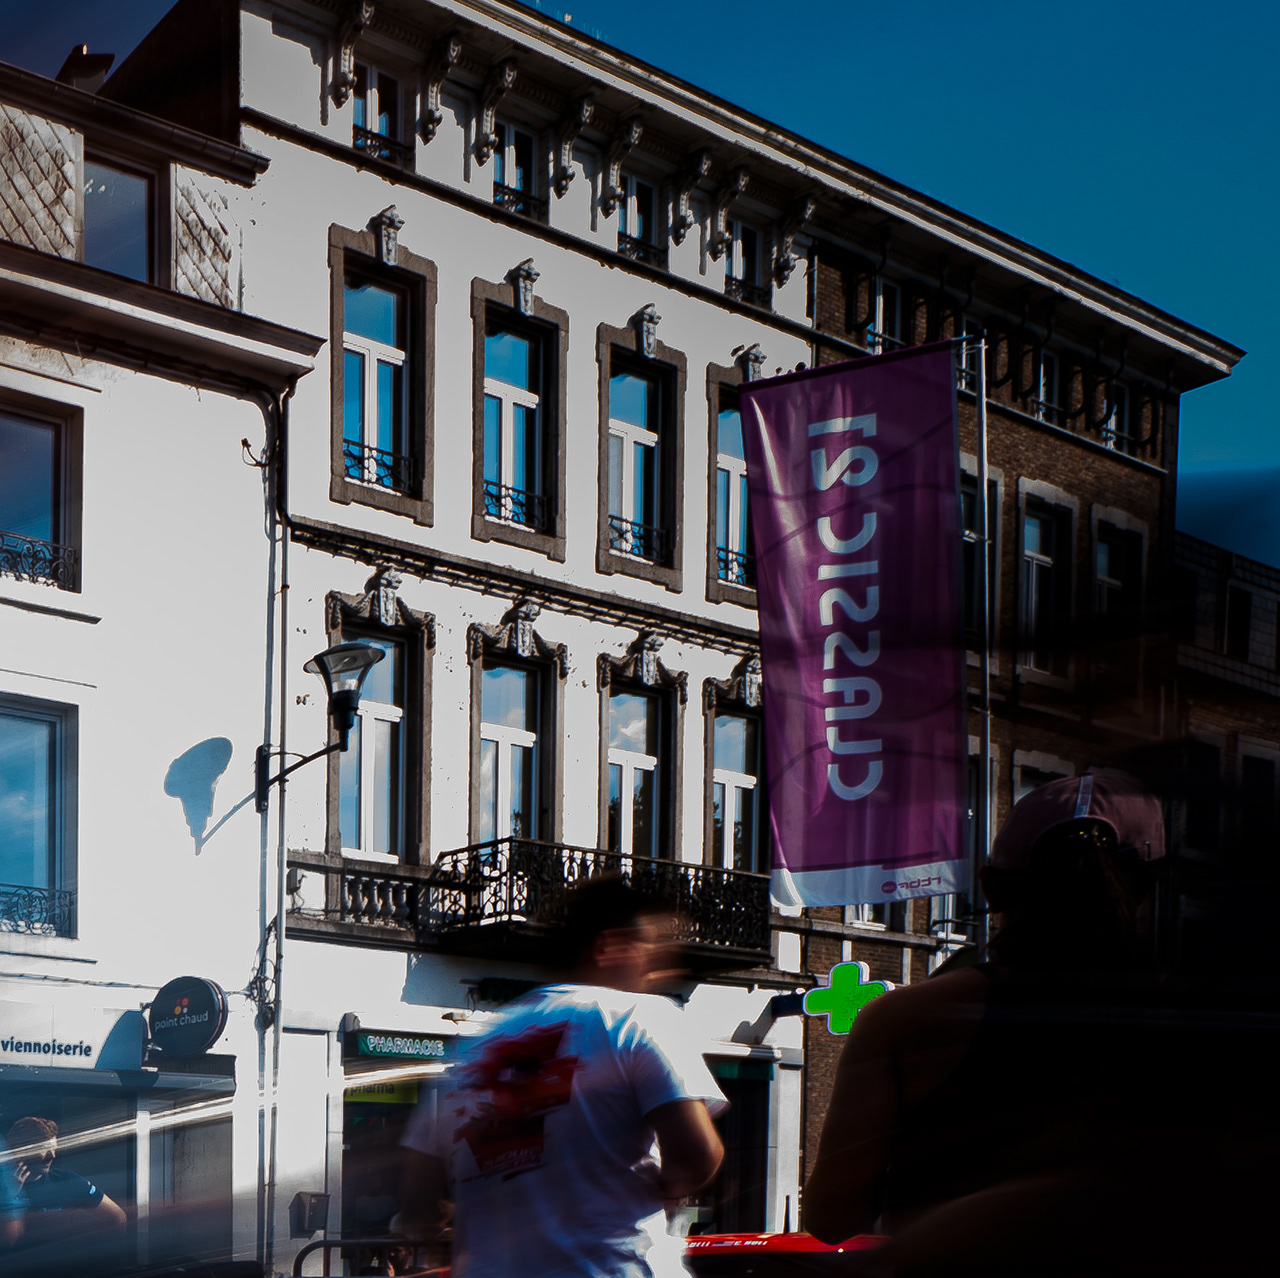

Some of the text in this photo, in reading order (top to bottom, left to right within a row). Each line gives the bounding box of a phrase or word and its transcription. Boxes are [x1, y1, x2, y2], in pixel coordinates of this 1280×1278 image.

[154, 1010, 209, 1032] point chaud
[1, 1036, 92, 1057] viennoiserie
[366, 1034, 445, 1056] PHARMACIE
